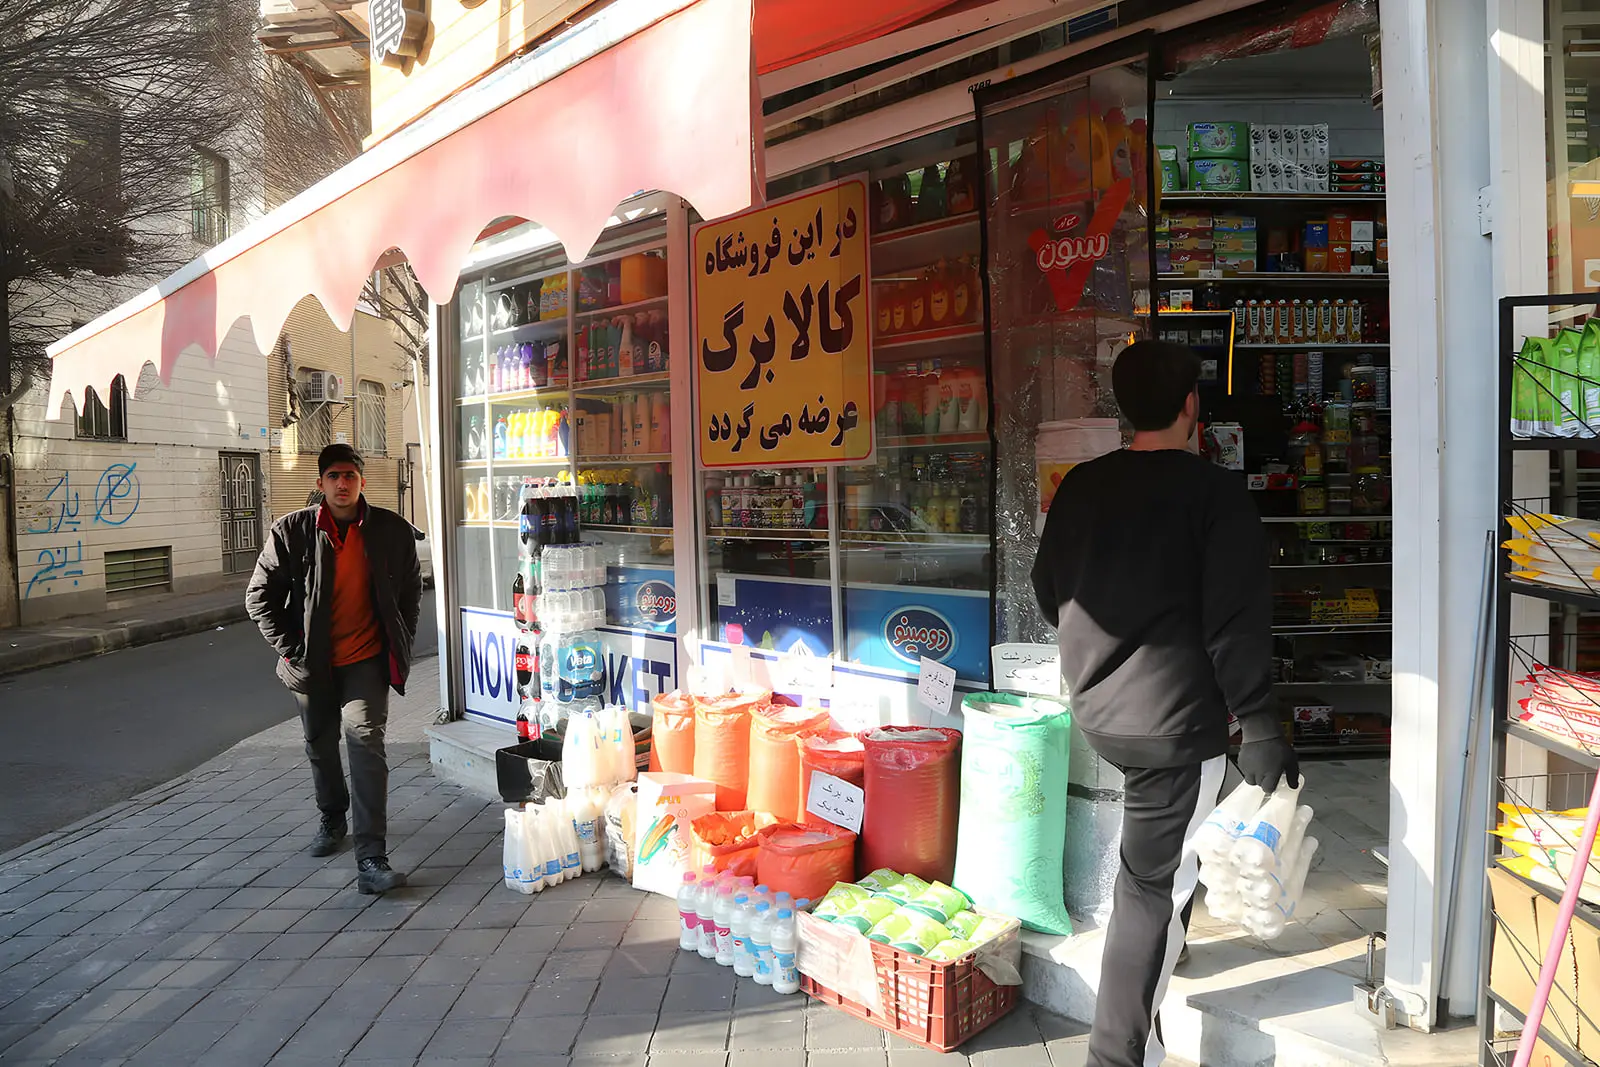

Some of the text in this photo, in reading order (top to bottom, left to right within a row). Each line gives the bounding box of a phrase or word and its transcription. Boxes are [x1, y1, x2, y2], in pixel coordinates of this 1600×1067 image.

[705, 206, 857, 277] در این فروشگاه
[1037, 233, 1107, 271] سون
[708, 394, 858, 452] عرضه می گردد
[640, 586, 676, 617] دومینو
[893, 615, 950, 653] دومینو
[470, 630, 517, 703] NOV
